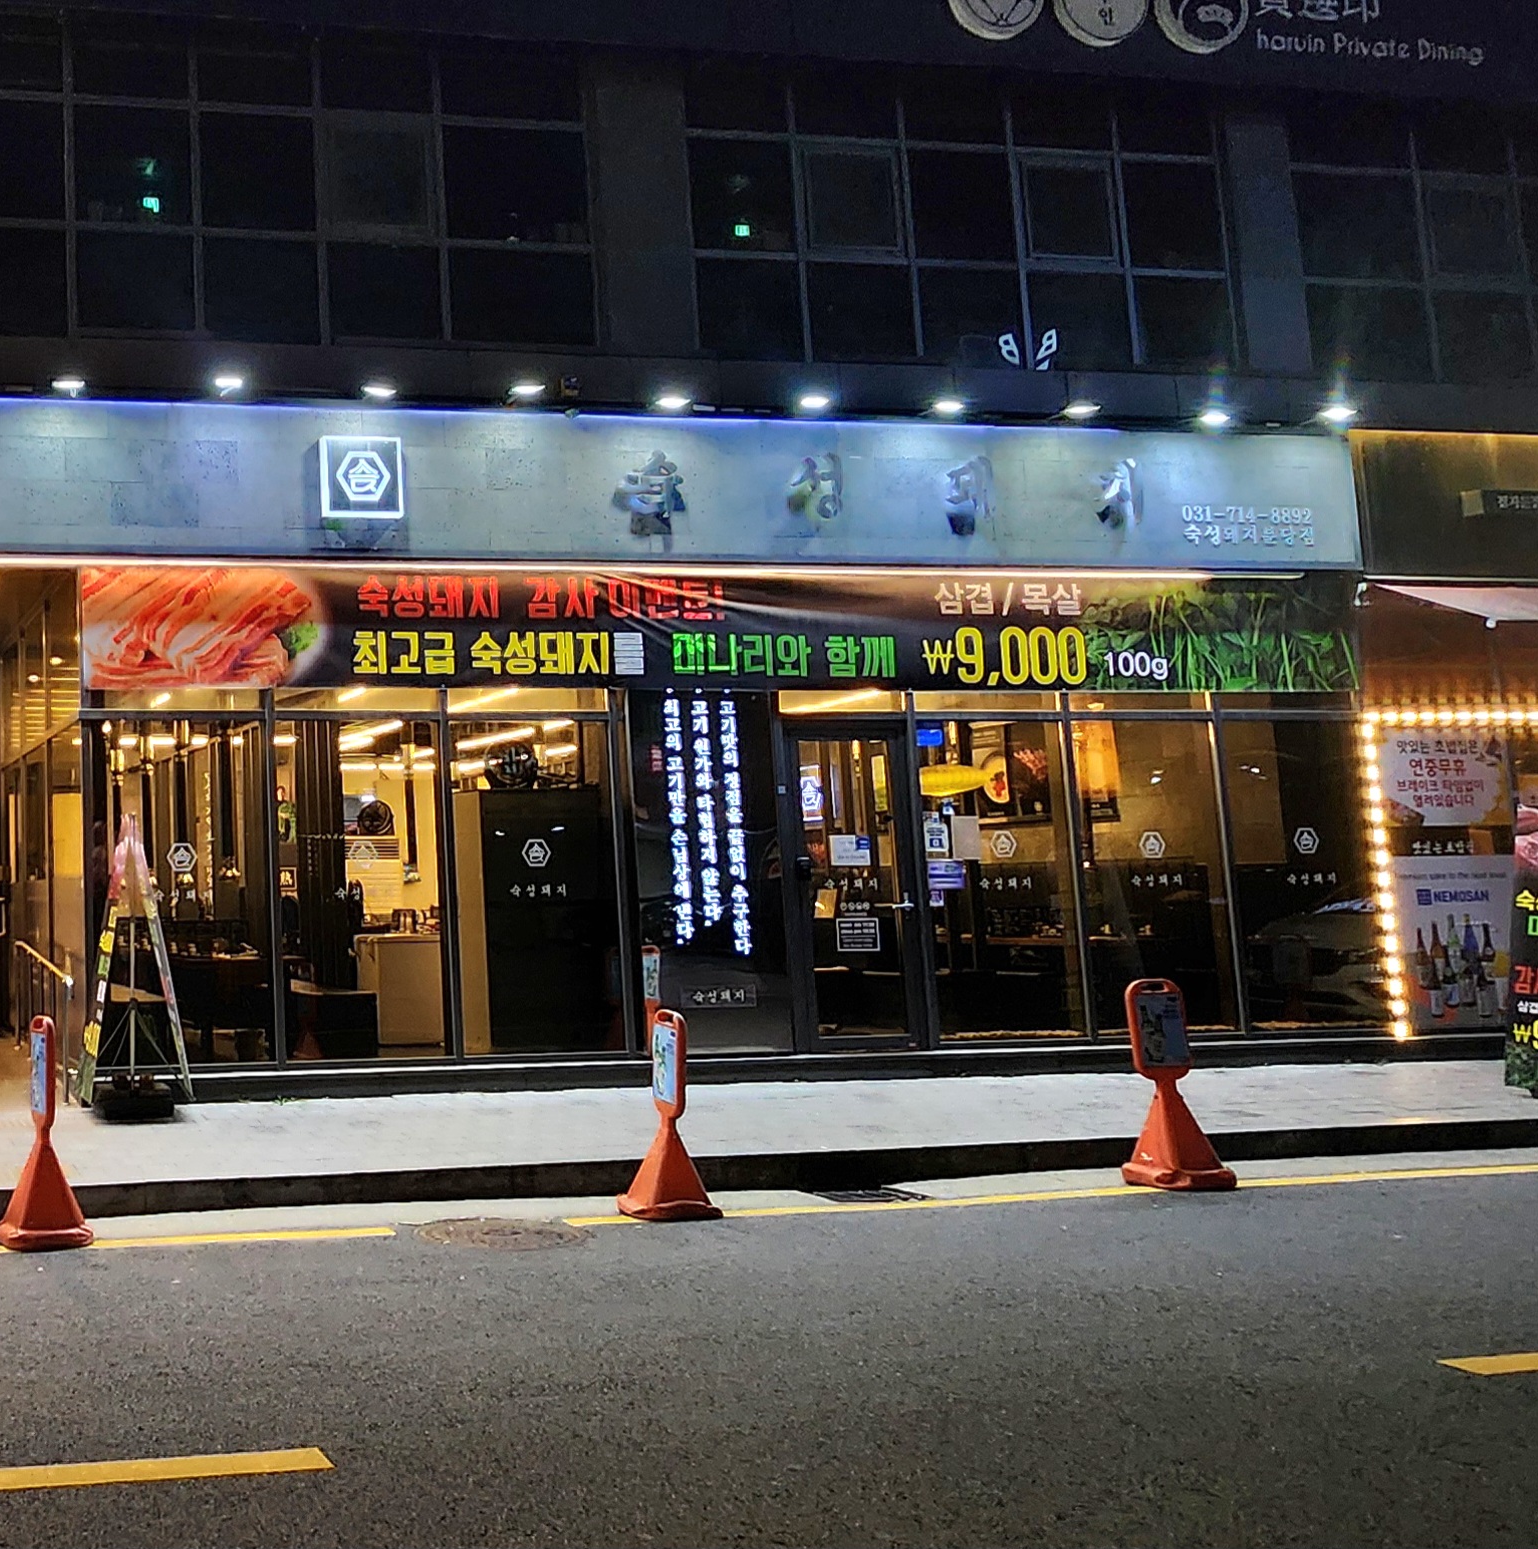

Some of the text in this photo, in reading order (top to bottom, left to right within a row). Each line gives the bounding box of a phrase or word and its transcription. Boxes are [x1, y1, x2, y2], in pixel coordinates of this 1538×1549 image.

[1333, 32, 1410, 58] Private
[1418, 38, 1484, 66] Dining
[1181, 504, 1313, 525] 031-714-8892
[357, 573, 501, 620] 숙성돼지
[524, 575, 600, 620] 감사
[935, 581, 993, 617] 삼겹
[1023, 582, 1082, 617] 목살
[352, 630, 897, 679] 최고급 숙성돼지를 미나리와 함께
[921, 625, 1170, 687] ₩9,000 100g
[691, 700, 710, 734] 고기
[1409, 758, 1467, 777] 연중무휴
[1433, 889, 1489, 902] NEMOSAN
